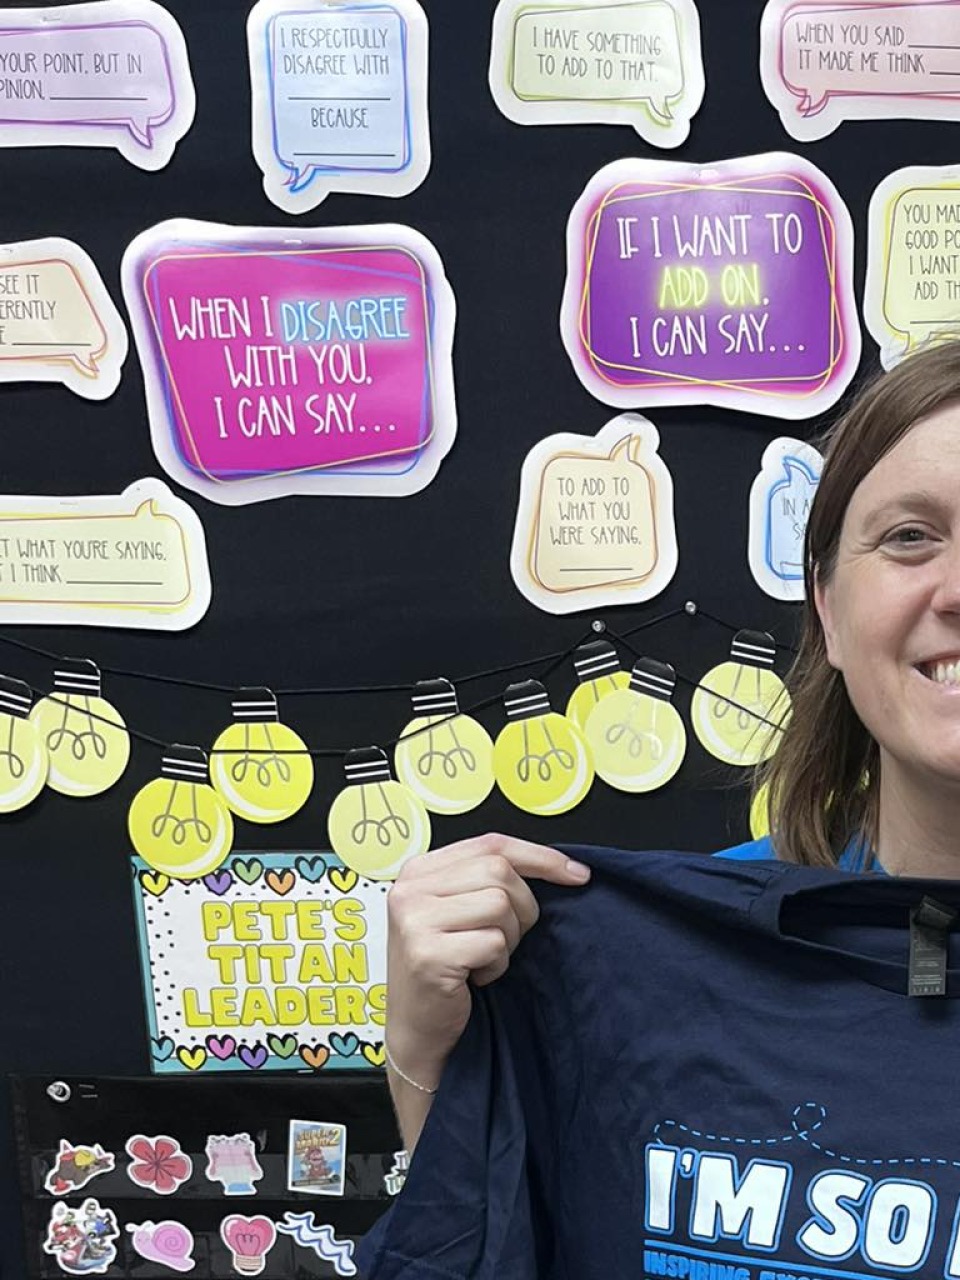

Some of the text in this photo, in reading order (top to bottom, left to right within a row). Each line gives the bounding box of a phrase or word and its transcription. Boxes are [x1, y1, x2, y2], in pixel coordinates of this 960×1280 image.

[281, 28, 389, 48] I RESPECTFULLY
[533, 27, 661, 55] I HAVE SOMETHING
[795, 23, 904, 46] WHEN YOU SAID
[0, 52, 37, 73] YOUR
[94, 53, 119, 74] BUT
[127, 53, 142, 74] IN
[283, 55, 390, 75] DISAGREE WITH
[536, 54, 555, 75] TO
[561, 56, 587, 77] ADD
[595, 59, 612, 79] TO
[799, 49, 925, 73] IT MADE ME THINK
[311, 108, 369, 129] BECAUSE
[904, 204, 930, 224] YOU
[616, 213, 802, 259] IF I WANT TO
[905, 230, 939, 249] GOOD
[909, 255, 914, 275] I
[920, 255, 959, 275] WANT
[26, 274, 40, 294] IT
[659, 266, 709, 309] ADD
[914, 281, 939, 300] ADD
[168, 296, 410, 342] WHEN I DISAGREE
[629, 313, 805, 358] I CAN SAY...
[224, 344, 298, 389] WITH
[214, 392, 396, 439] I CAN SAY...
[557, 477, 629, 496] TO ADD TO
[559, 502, 630, 520] WHAT YOU
[783, 497, 796, 515] IN
[550, 526, 585, 545] WERE
[16, 538, 56, 558] WHAT
[11, 563, 15, 583] I
[21, 564, 62, 583] THINK
[201, 898, 368, 942] PETE'S
[207, 943, 369, 985] TITAN
[182, 984, 388, 1028] LEADERS
[644, 1143, 793, 1252] I'M
[795, 1168, 938, 1273] SO
